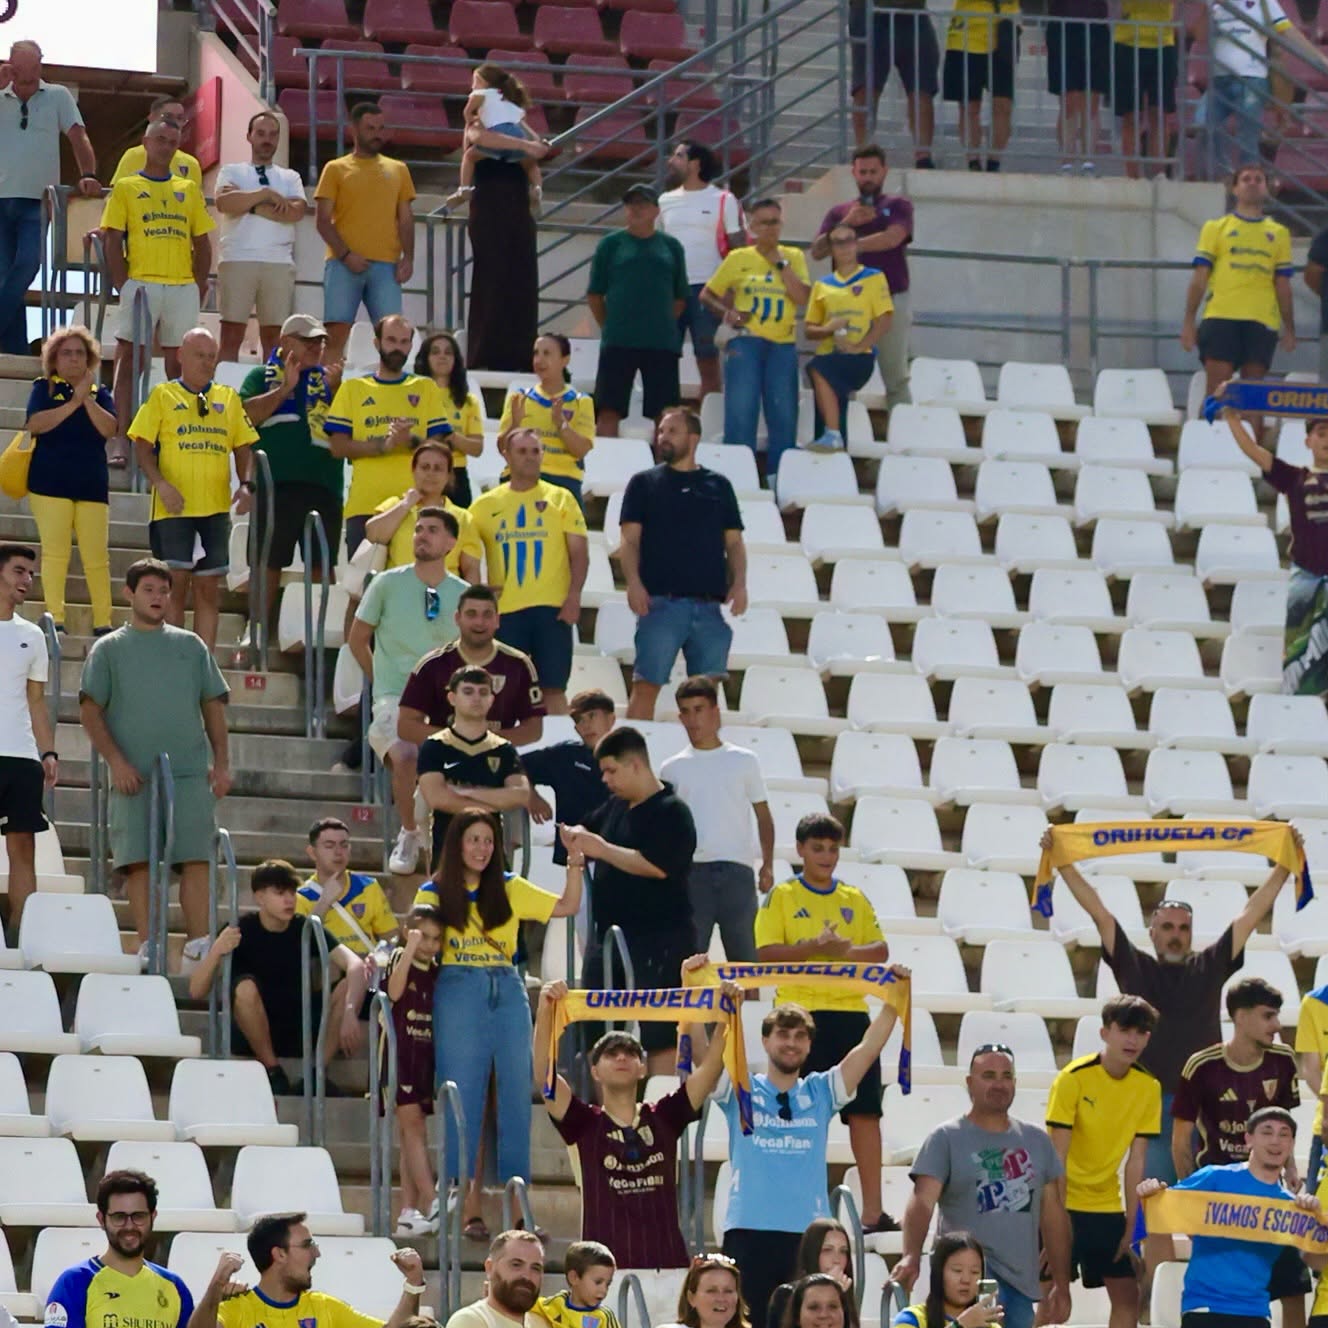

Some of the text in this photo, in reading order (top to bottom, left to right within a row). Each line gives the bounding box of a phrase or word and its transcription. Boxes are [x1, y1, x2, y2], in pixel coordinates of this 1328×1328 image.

[1093, 827, 1254, 847] ORIHUELA CF
[586, 989, 714, 1009] ORIHUELA
